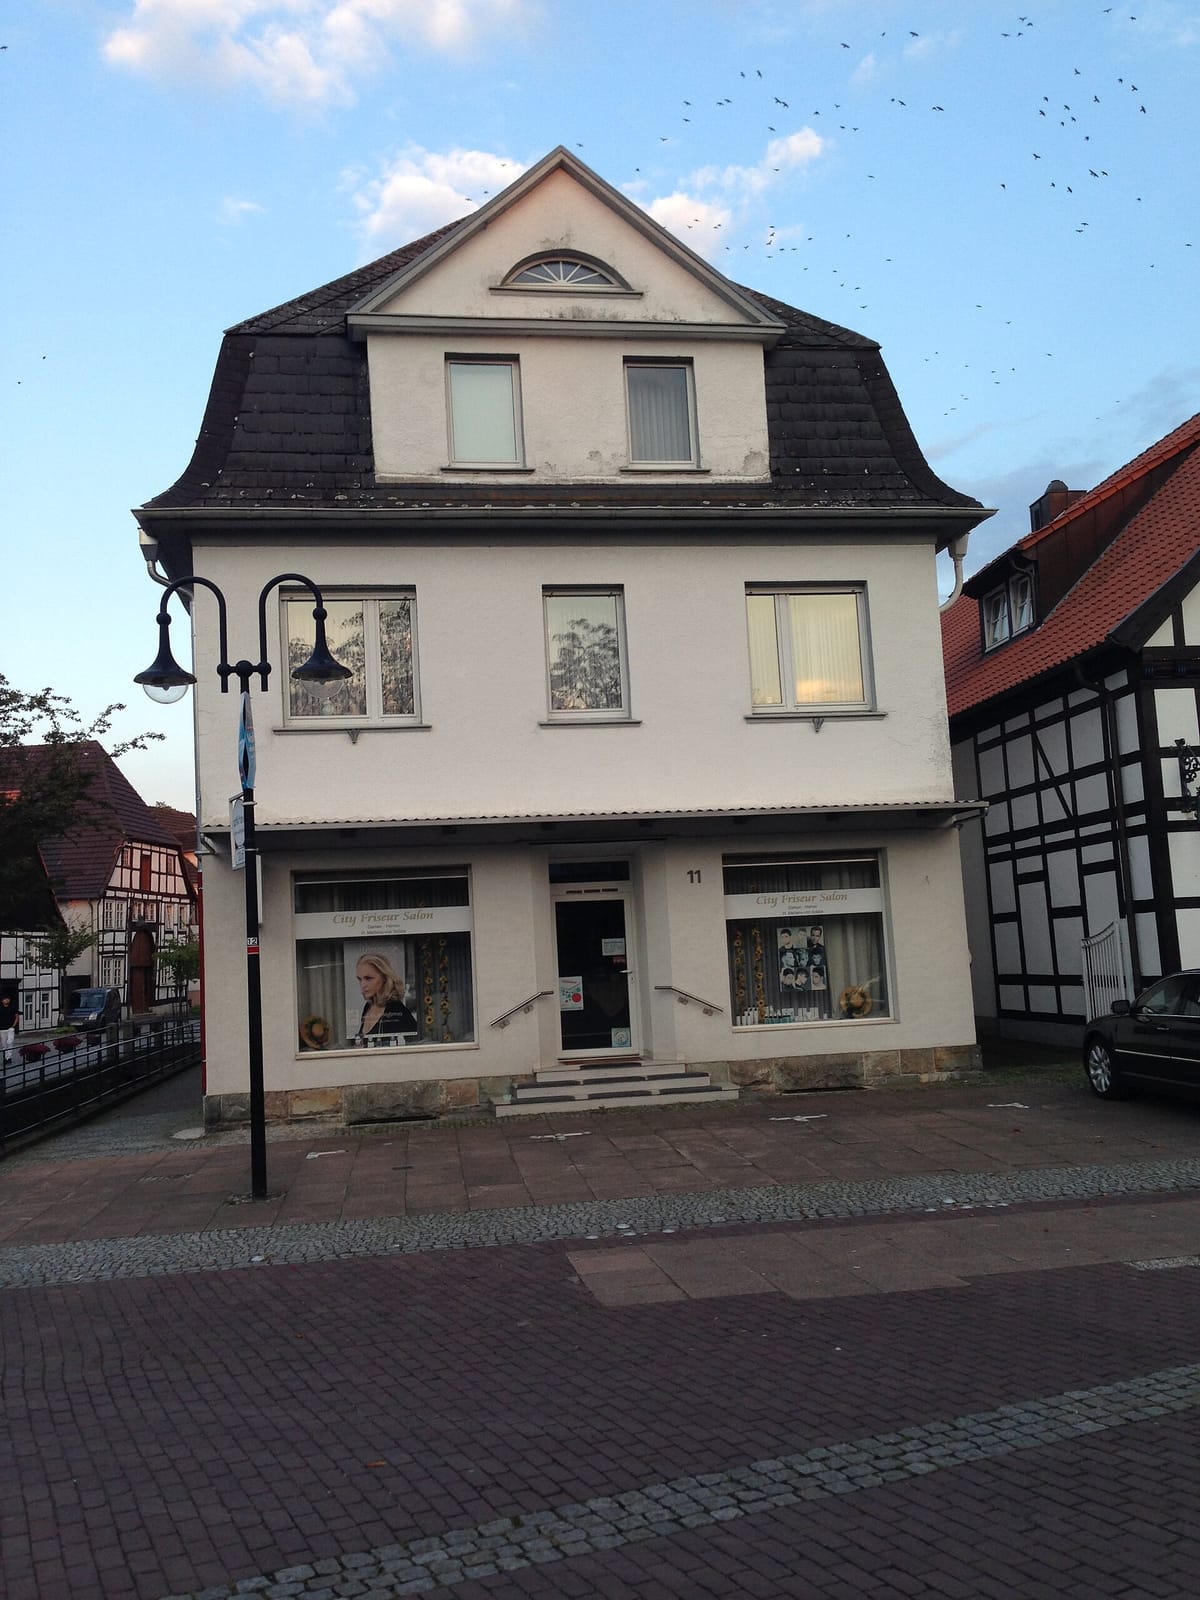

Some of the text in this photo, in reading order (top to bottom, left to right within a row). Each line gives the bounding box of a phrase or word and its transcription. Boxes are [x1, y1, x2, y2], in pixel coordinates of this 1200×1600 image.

[687, 870, 702, 884] 11
[756, 895, 778, 907] City
[782, 894, 817, 904] Friseur
[819, 891, 848, 902] Salon
[332, 909, 434, 927] City Friseur Salon
[248, 937, 257, 945] 12
